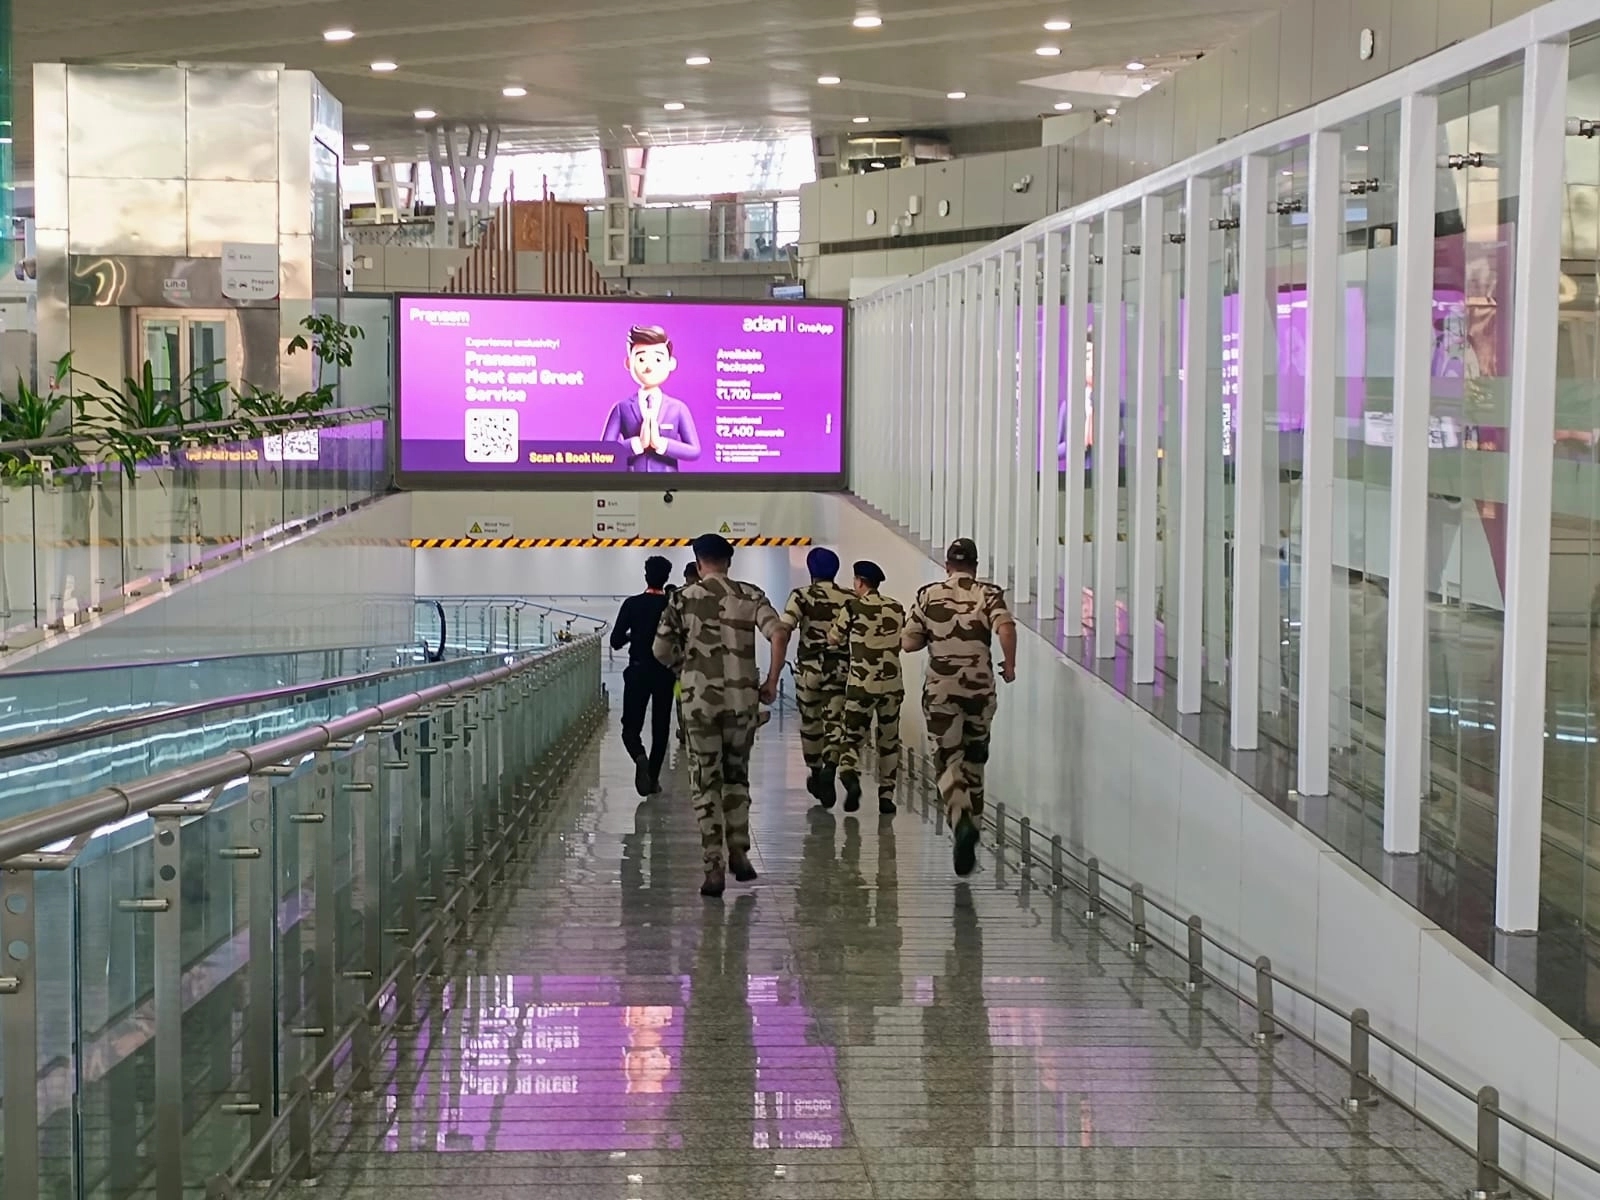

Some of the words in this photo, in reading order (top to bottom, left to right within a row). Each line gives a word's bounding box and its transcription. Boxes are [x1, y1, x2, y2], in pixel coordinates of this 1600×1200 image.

[409, 307, 470, 323] Pranaam
[742, 315, 787, 332] adani
[797, 322, 834, 335] OneApp
[465, 350, 537, 367] Pranaam
[465, 368, 505, 384] Meet
[507, 369, 538, 384] and
[540, 369, 584, 385] Greet
[465, 386, 527, 402] Service
[529, 452, 554, 463] Scan
[556, 452, 564, 463] &
[565, 452, 591, 463] Book
[592, 453, 615, 463] Now
